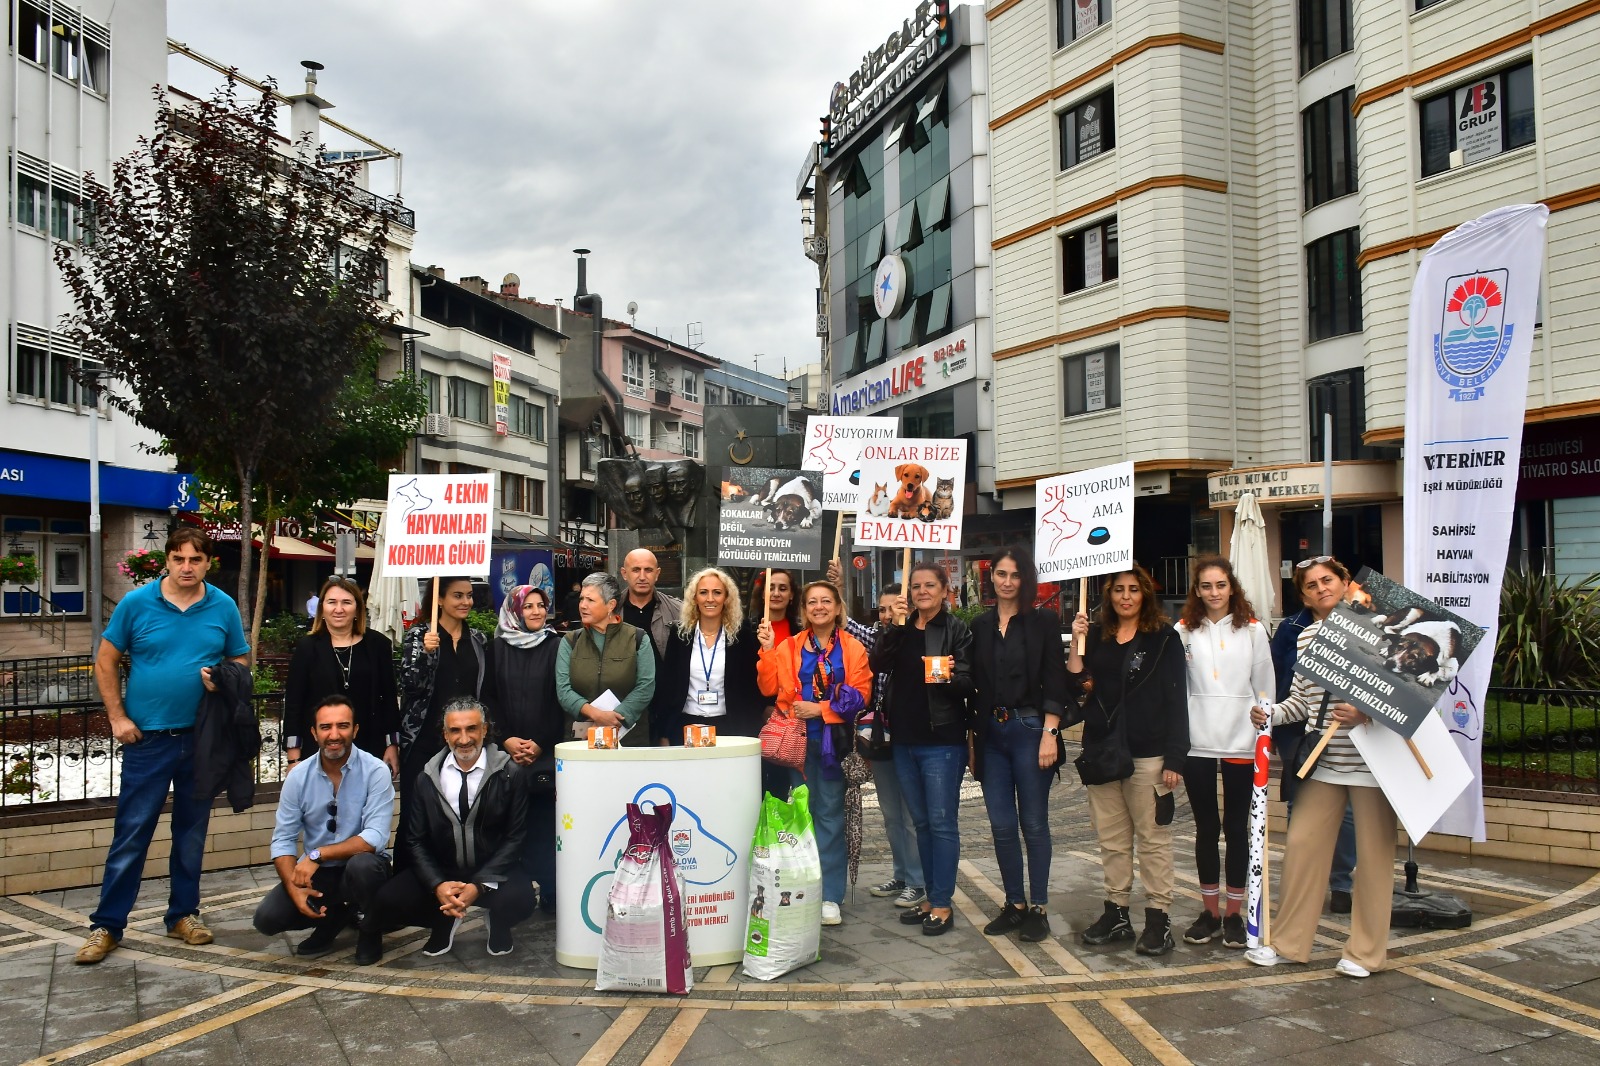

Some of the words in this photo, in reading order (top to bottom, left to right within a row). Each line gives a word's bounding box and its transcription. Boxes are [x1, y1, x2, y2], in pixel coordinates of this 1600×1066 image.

[830, 84, 884, 148] SÜRÜCÜ
[885, 37, 938, 98] KURSU
[1460, 81, 1497, 120] AFB
[1459, 110, 1497, 131] GRUP
[1434, 342, 1450, 382] YALOVA
[1458, 334, 1512, 386] BELEDİYESİ
[1459, 393, 1476, 401] 1927
[814, 424, 893, 439] SUSUYORUM
[864, 446, 918, 461] ONLAR
[924, 444, 960, 461] BİZE
[1521, 461, 1568, 479] TİYATRO
[1219, 475, 1240, 487] UĞUR
[1245, 471, 1288, 485] MUMCU
[1445, 477, 1503, 491] MÜDÜRLÜĞÜ
[444, 483, 453, 504] 4
[456, 479, 489, 504] EKİM
[1044, 475, 1130, 502] SUSUYORUM
[721, 509, 763, 519] SOKAKLARI
[1092, 502, 1123, 518] AMA
[407, 513, 487, 535] HAYVANLARI
[720, 521, 746, 533] DEĞİL,
[1432, 523, 1476, 536] SAHİPSİZ
[860, 521, 958, 544] EMANET
[719, 535, 754, 547] İÇİNİZDE
[755, 536, 791, 547] BÜYÜYEN
[388, 544, 446, 566] KORUMA
[448, 540, 486, 565] GÜNÜ
[719, 548, 762, 561] KÖTÜLÜĞÜ
[764, 550, 811, 563] TEMİZLEYİN!
[1437, 549, 1473, 560] HAYVAN
[1039, 549, 1129, 574] KONUŞAMIYORUM
[1433, 595, 1471, 608] MERKEZİ
[1328, 611, 1381, 647] SOKAKLARI
[1318, 625, 1349, 651] DEĞİL,
[1308, 638, 1352, 671] İÇİNİZDE
[1349, 664, 1395, 696] BÜYÜYEN
[1298, 654, 1352, 690] KÖTÜLÜĞÜ
[1349, 684, 1409, 725] TEMİZLEYİN!
[677, 857, 697, 865] LOVA
[698, 889, 735, 903] MÜDÜRLÜĞÜ
[694, 904, 717, 915] HAYVAN
[704, 914, 729, 926] MERKEZİ
